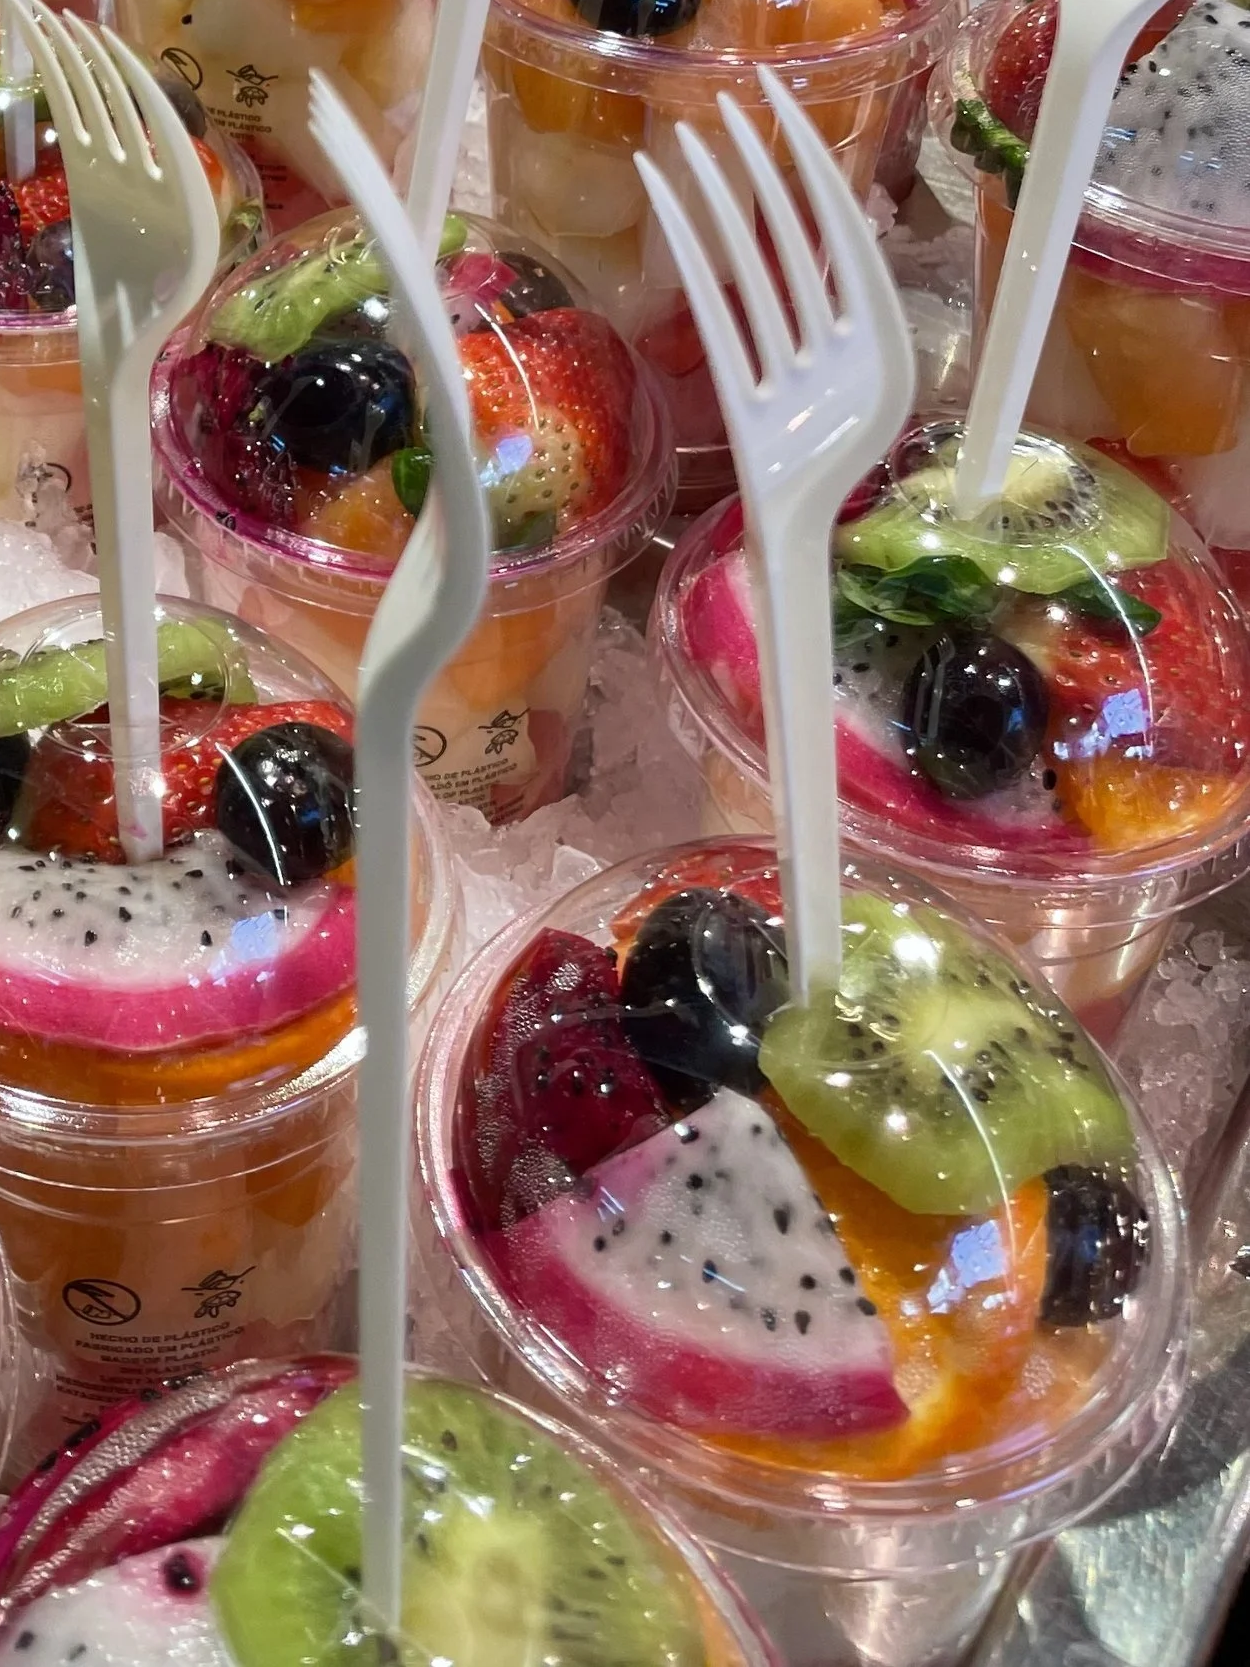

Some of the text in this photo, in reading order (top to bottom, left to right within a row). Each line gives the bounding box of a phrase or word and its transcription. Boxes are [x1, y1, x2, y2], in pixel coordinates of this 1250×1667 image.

[75, 1340, 154, 1354] FABRICADO
[180, 1326, 245, 1352] PLÁSTICO
[89, 1321, 230, 1344] HECHO DE PLÁSTICO
